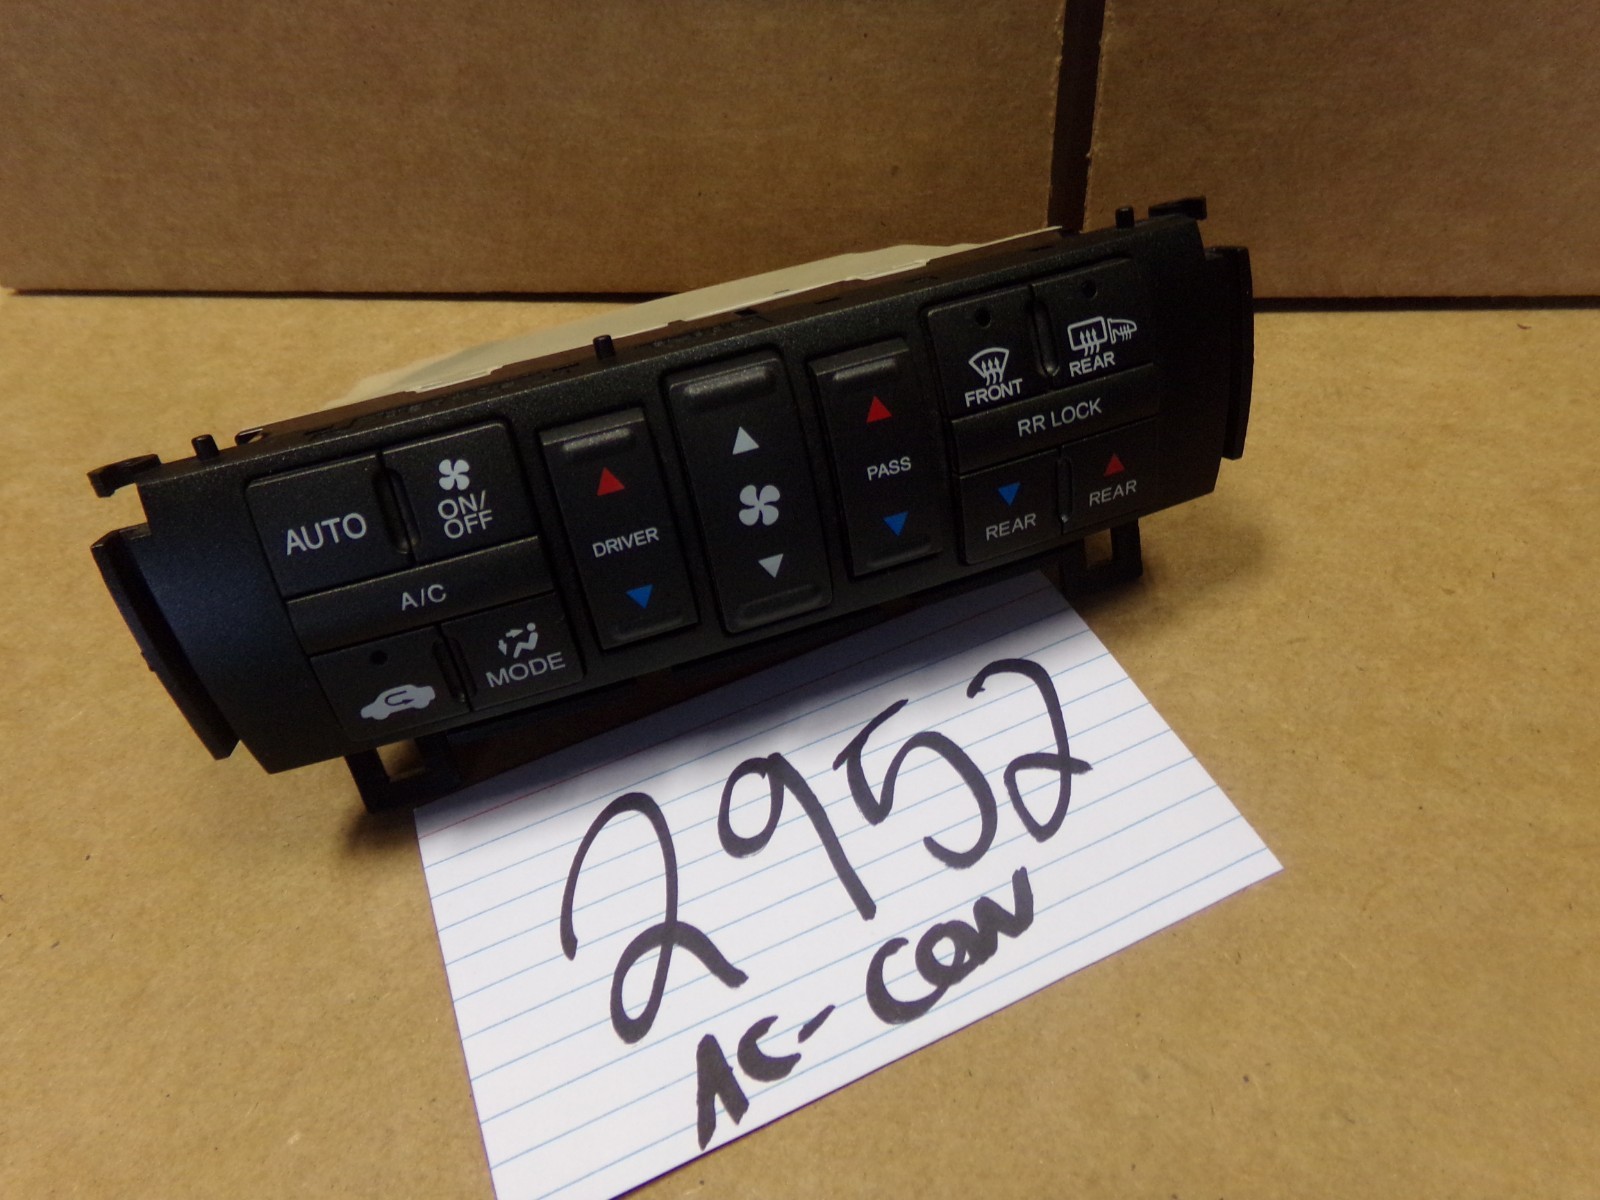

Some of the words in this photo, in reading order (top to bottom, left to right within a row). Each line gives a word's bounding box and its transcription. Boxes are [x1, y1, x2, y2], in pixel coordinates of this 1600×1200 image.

[1069, 351, 1116, 377] REAR
[964, 378, 1024, 408] FRONT
[1017, 414, 1047, 437] RR
[1050, 397, 1103, 429] LOCK
[866, 456, 912, 481] PASS
[437, 490, 487, 521] ON/
[1088, 479, 1137, 507] REAR
[285, 512, 368, 555] AUTO
[443, 509, 494, 539] OFF
[985, 512, 1037, 541] REAR
[591, 526, 660, 558] DRIVER
[400, 584, 447, 611] A/C
[485, 652, 566, 688] MODE
[560, 658, 1093, 1043] 2952
